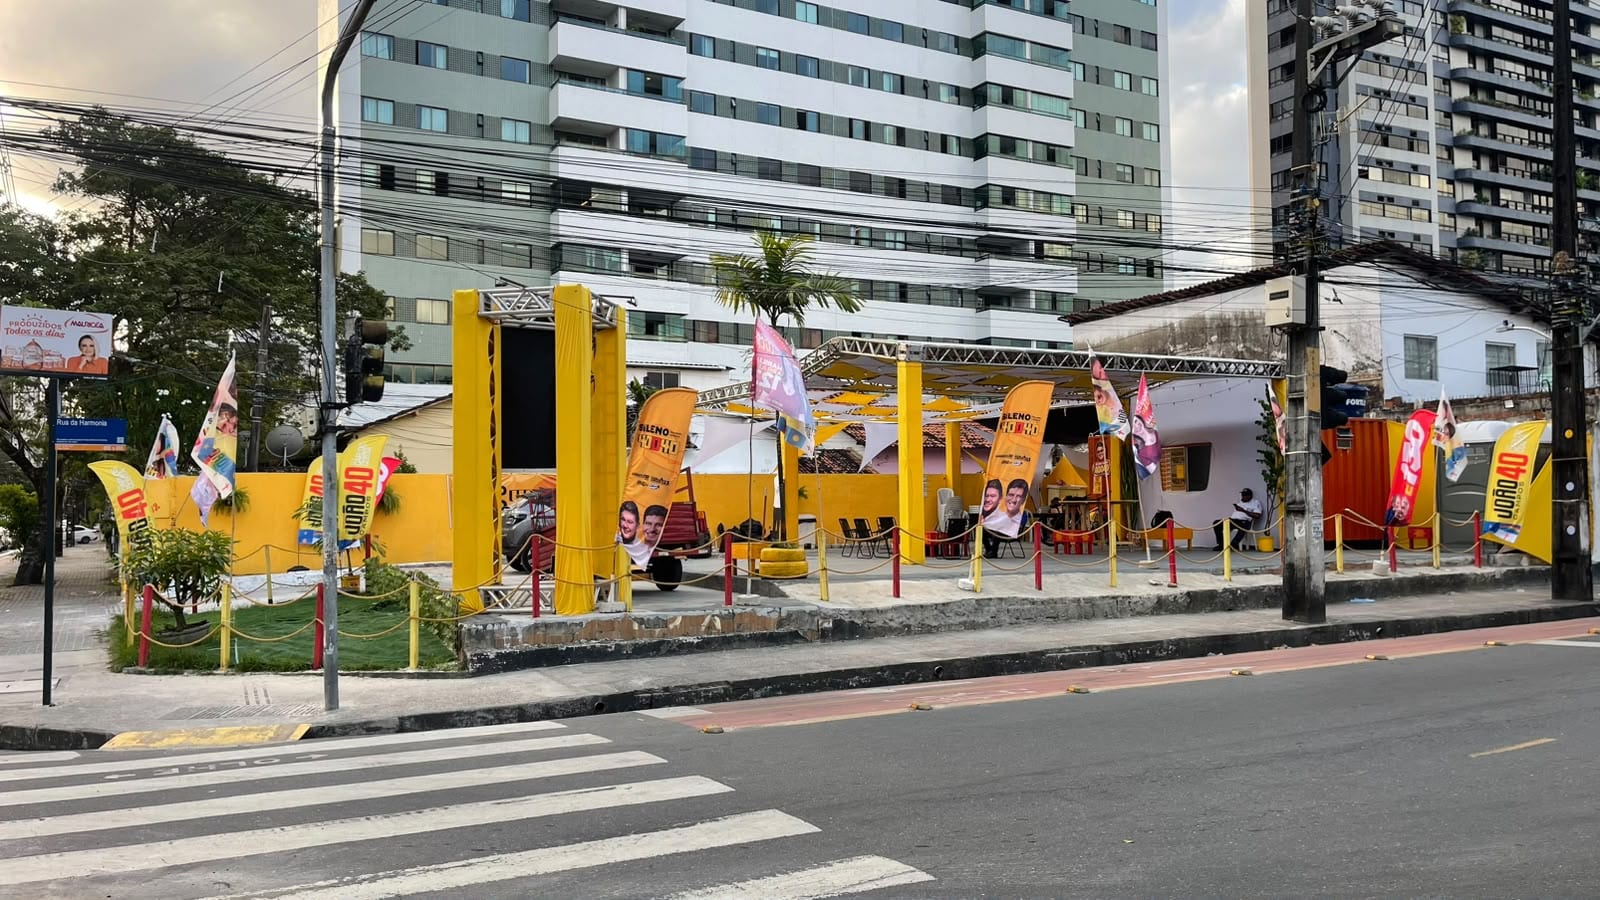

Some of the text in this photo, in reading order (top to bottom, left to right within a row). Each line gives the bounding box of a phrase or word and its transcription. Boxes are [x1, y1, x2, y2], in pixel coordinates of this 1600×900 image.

[4, 327, 31, 336] Todos
[32, 329, 43, 337] os
[56, 418, 69, 426] Rua
[79, 419, 108, 427] Harmonia
[344, 467, 374, 495] 40
[1496, 452, 1529, 481] 40
[117, 488, 148, 519] 40
[343, 494, 366, 535] JOÃO
[1492, 479, 1518, 519] JOÃO
[1512, 481, 1524, 520] CAMPOS
[360, 496, 371, 535] CAMPOS
